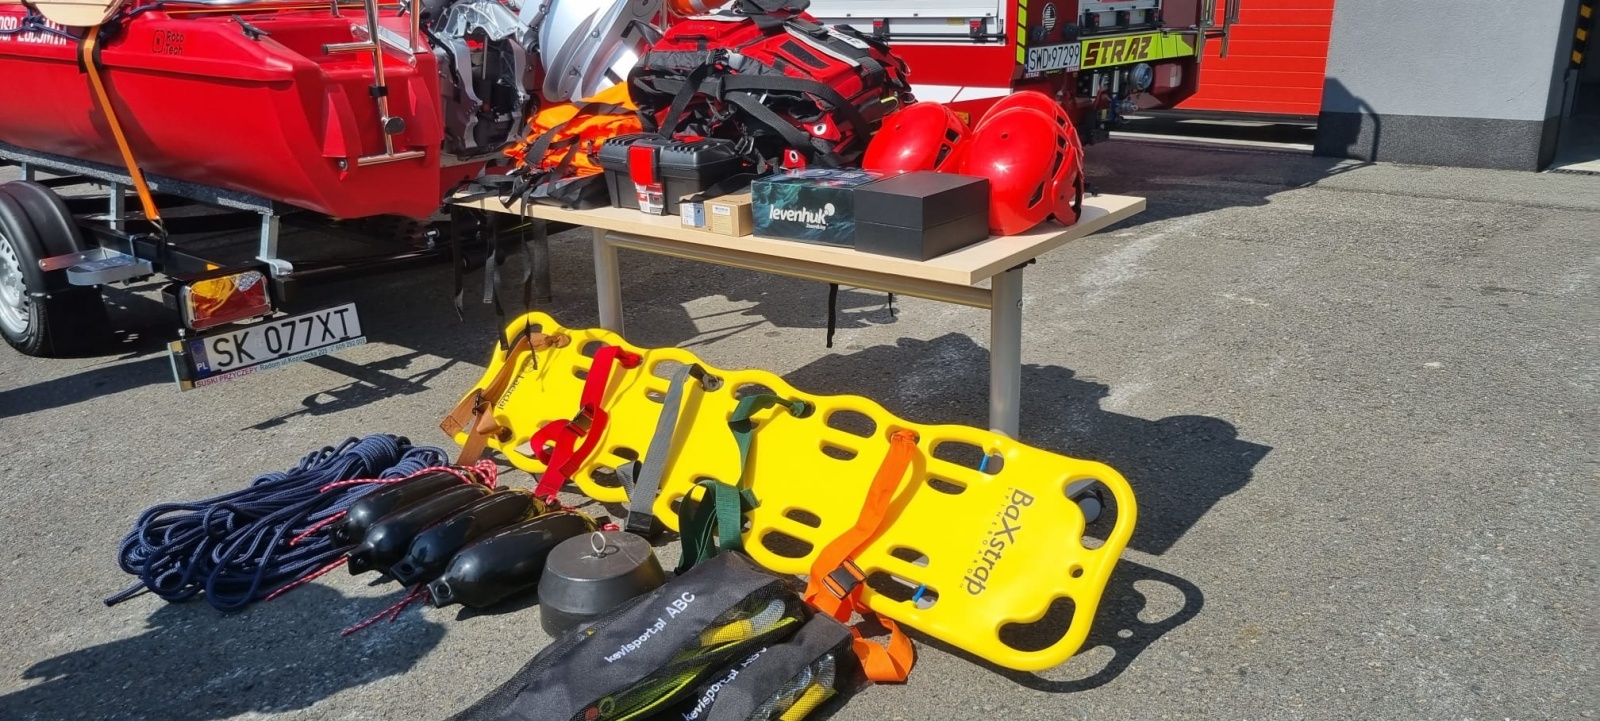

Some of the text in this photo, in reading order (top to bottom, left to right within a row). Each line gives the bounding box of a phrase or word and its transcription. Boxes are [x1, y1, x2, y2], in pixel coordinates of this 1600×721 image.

[167, 31, 184, 42] Roto
[166, 43, 182, 55] Tech
[1029, 44, 1080, 71] SWD 97299
[769, 204, 827, 225] levenhuk
[213, 308, 349, 367] SK 077XT
[196, 363, 208, 371] PL
[196, 377, 218, 388] SUSKI
[219, 366, 258, 382] PRZYCZEPY
[260, 362, 281, 371] Radom
[604, 592, 695, 663] kevisport.pl ABC
